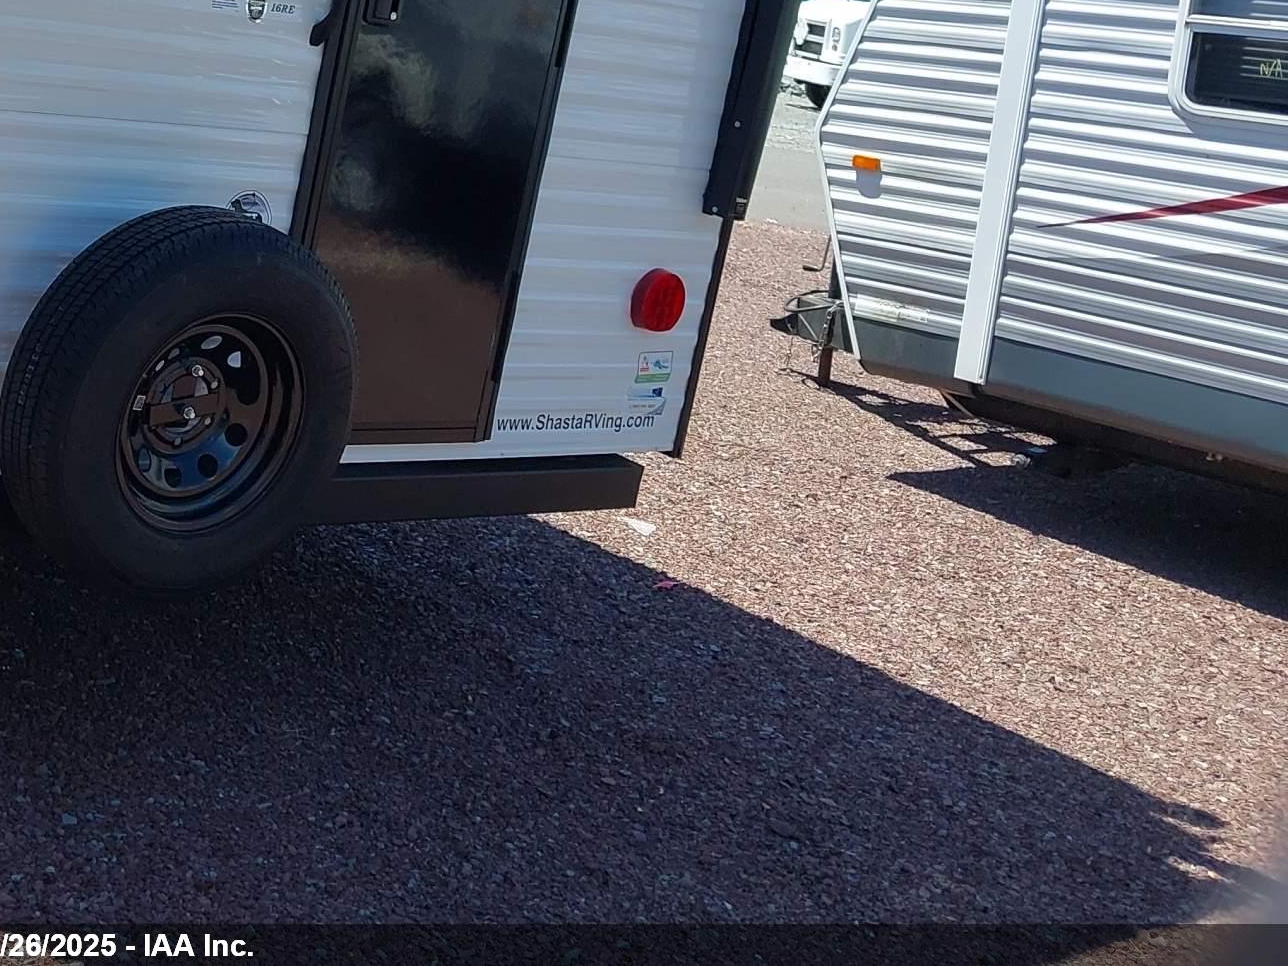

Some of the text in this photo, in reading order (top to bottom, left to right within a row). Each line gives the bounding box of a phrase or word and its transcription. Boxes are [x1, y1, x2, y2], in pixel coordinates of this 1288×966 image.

[270, 3, 296, 14] 16RE
[1259, 58, 1283, 79] N/A
[497, 413, 655, 432] www.ShastaRVing.com
